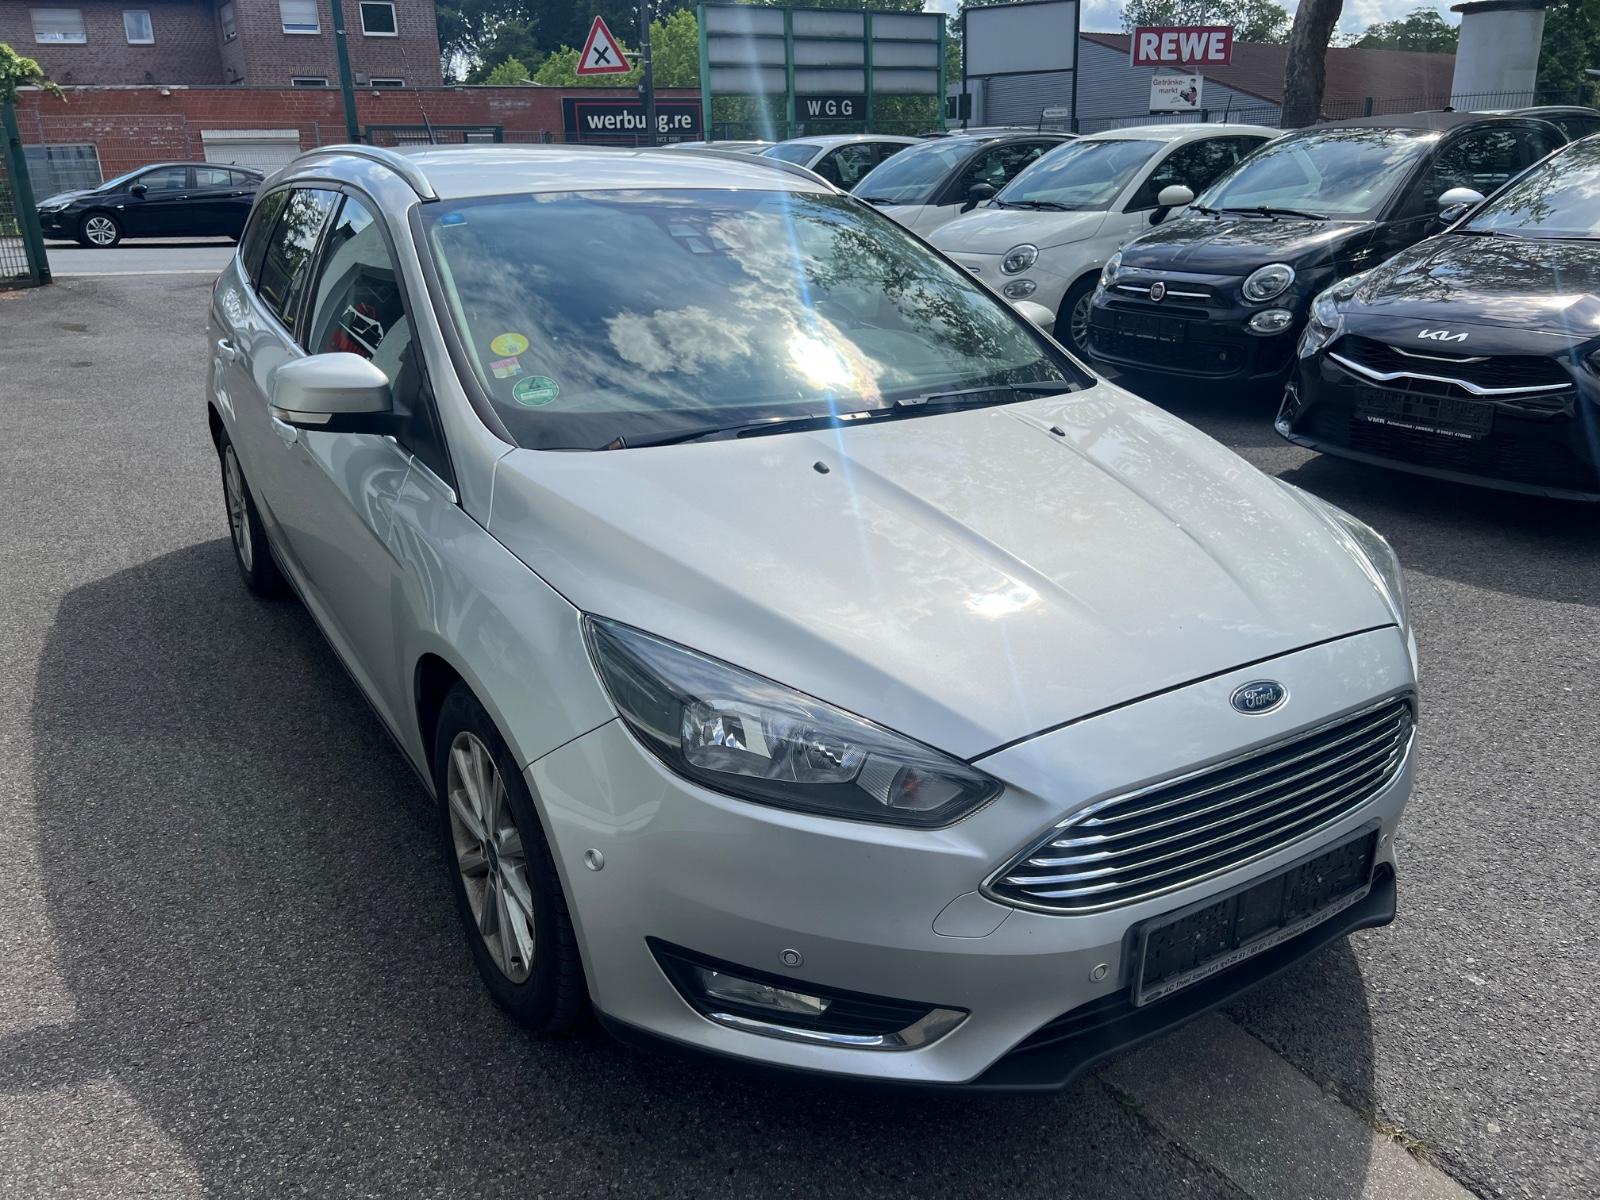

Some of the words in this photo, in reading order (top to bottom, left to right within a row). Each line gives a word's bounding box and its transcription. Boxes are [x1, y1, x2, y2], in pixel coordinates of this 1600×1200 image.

[1138, 32, 1226, 62] REWE
[587, 110, 692, 132] werbug.re
[1418, 329, 1469, 342] KIA
[1244, 687, 1276, 708] Ford
